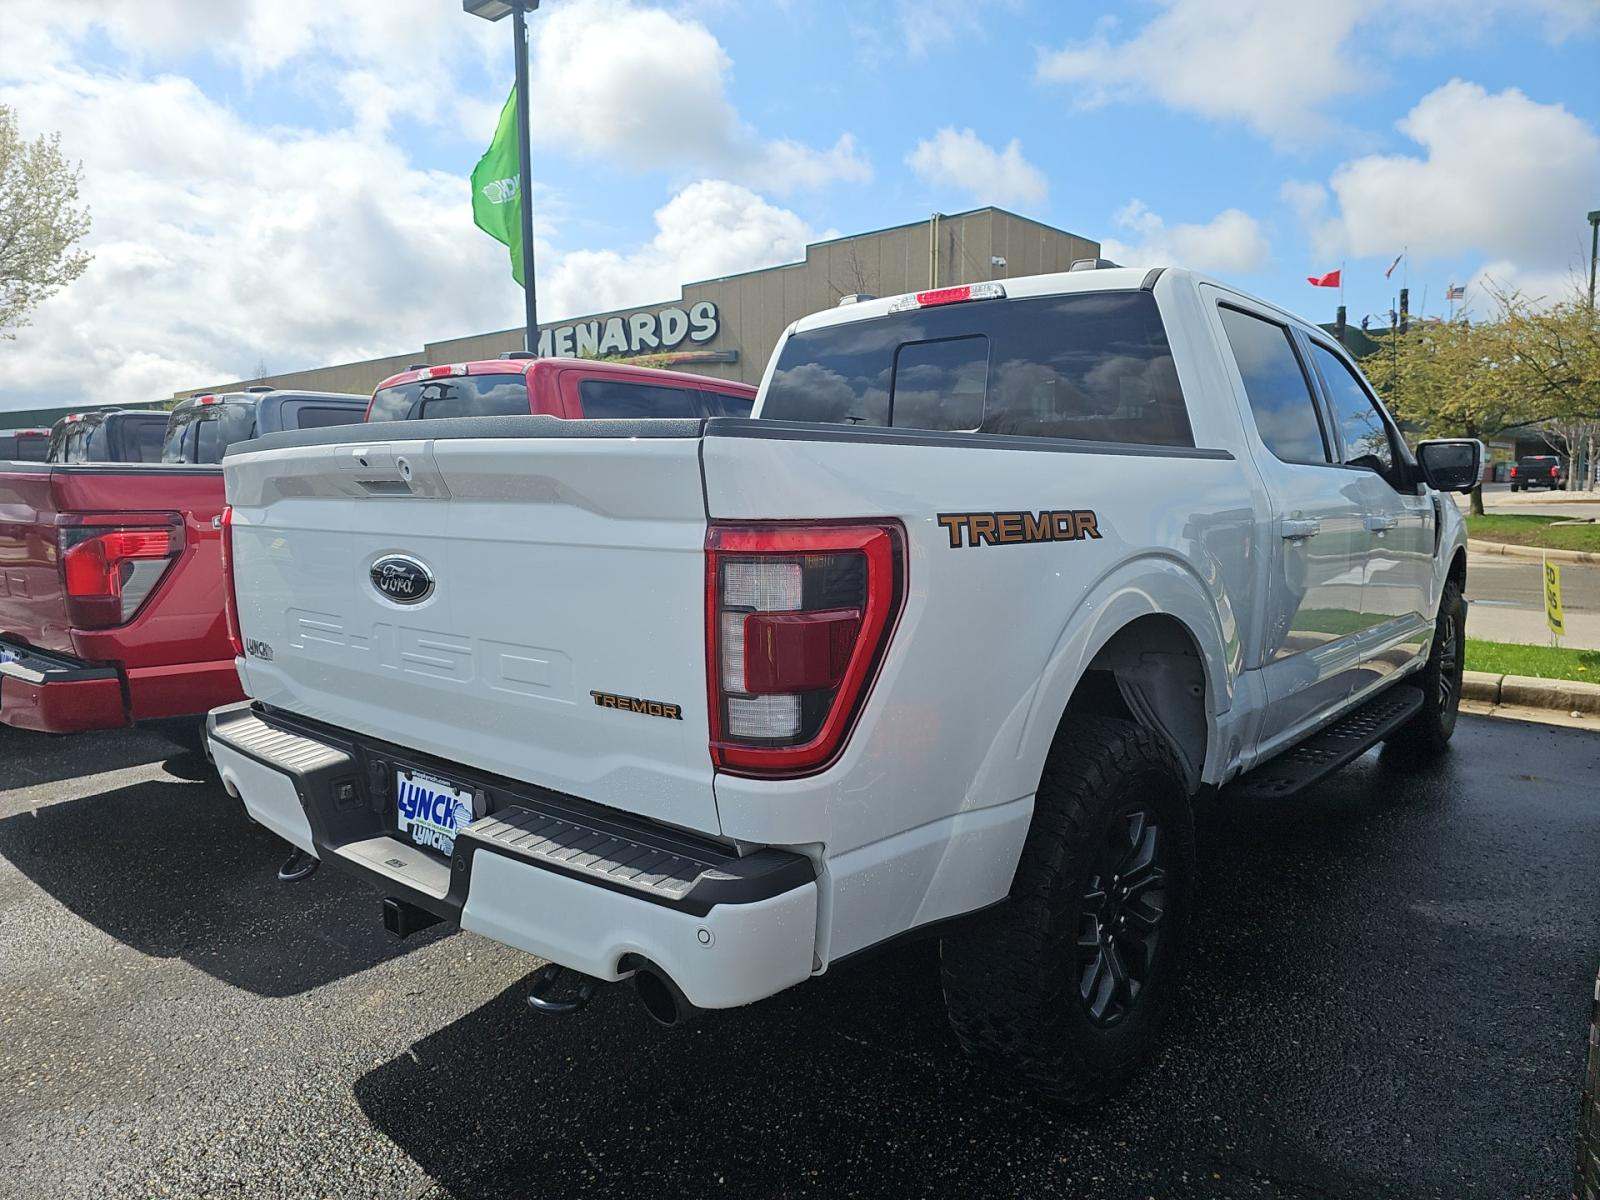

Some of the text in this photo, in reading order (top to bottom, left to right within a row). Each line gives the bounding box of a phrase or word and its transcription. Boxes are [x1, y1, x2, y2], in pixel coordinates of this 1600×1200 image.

[937, 510, 1103, 549] TREMOR
[380, 564, 416, 594] Ford
[590, 690, 684, 720] TREMOR
[398, 781, 458, 830] LYNCH
[412, 824, 446, 852] LYNCH
